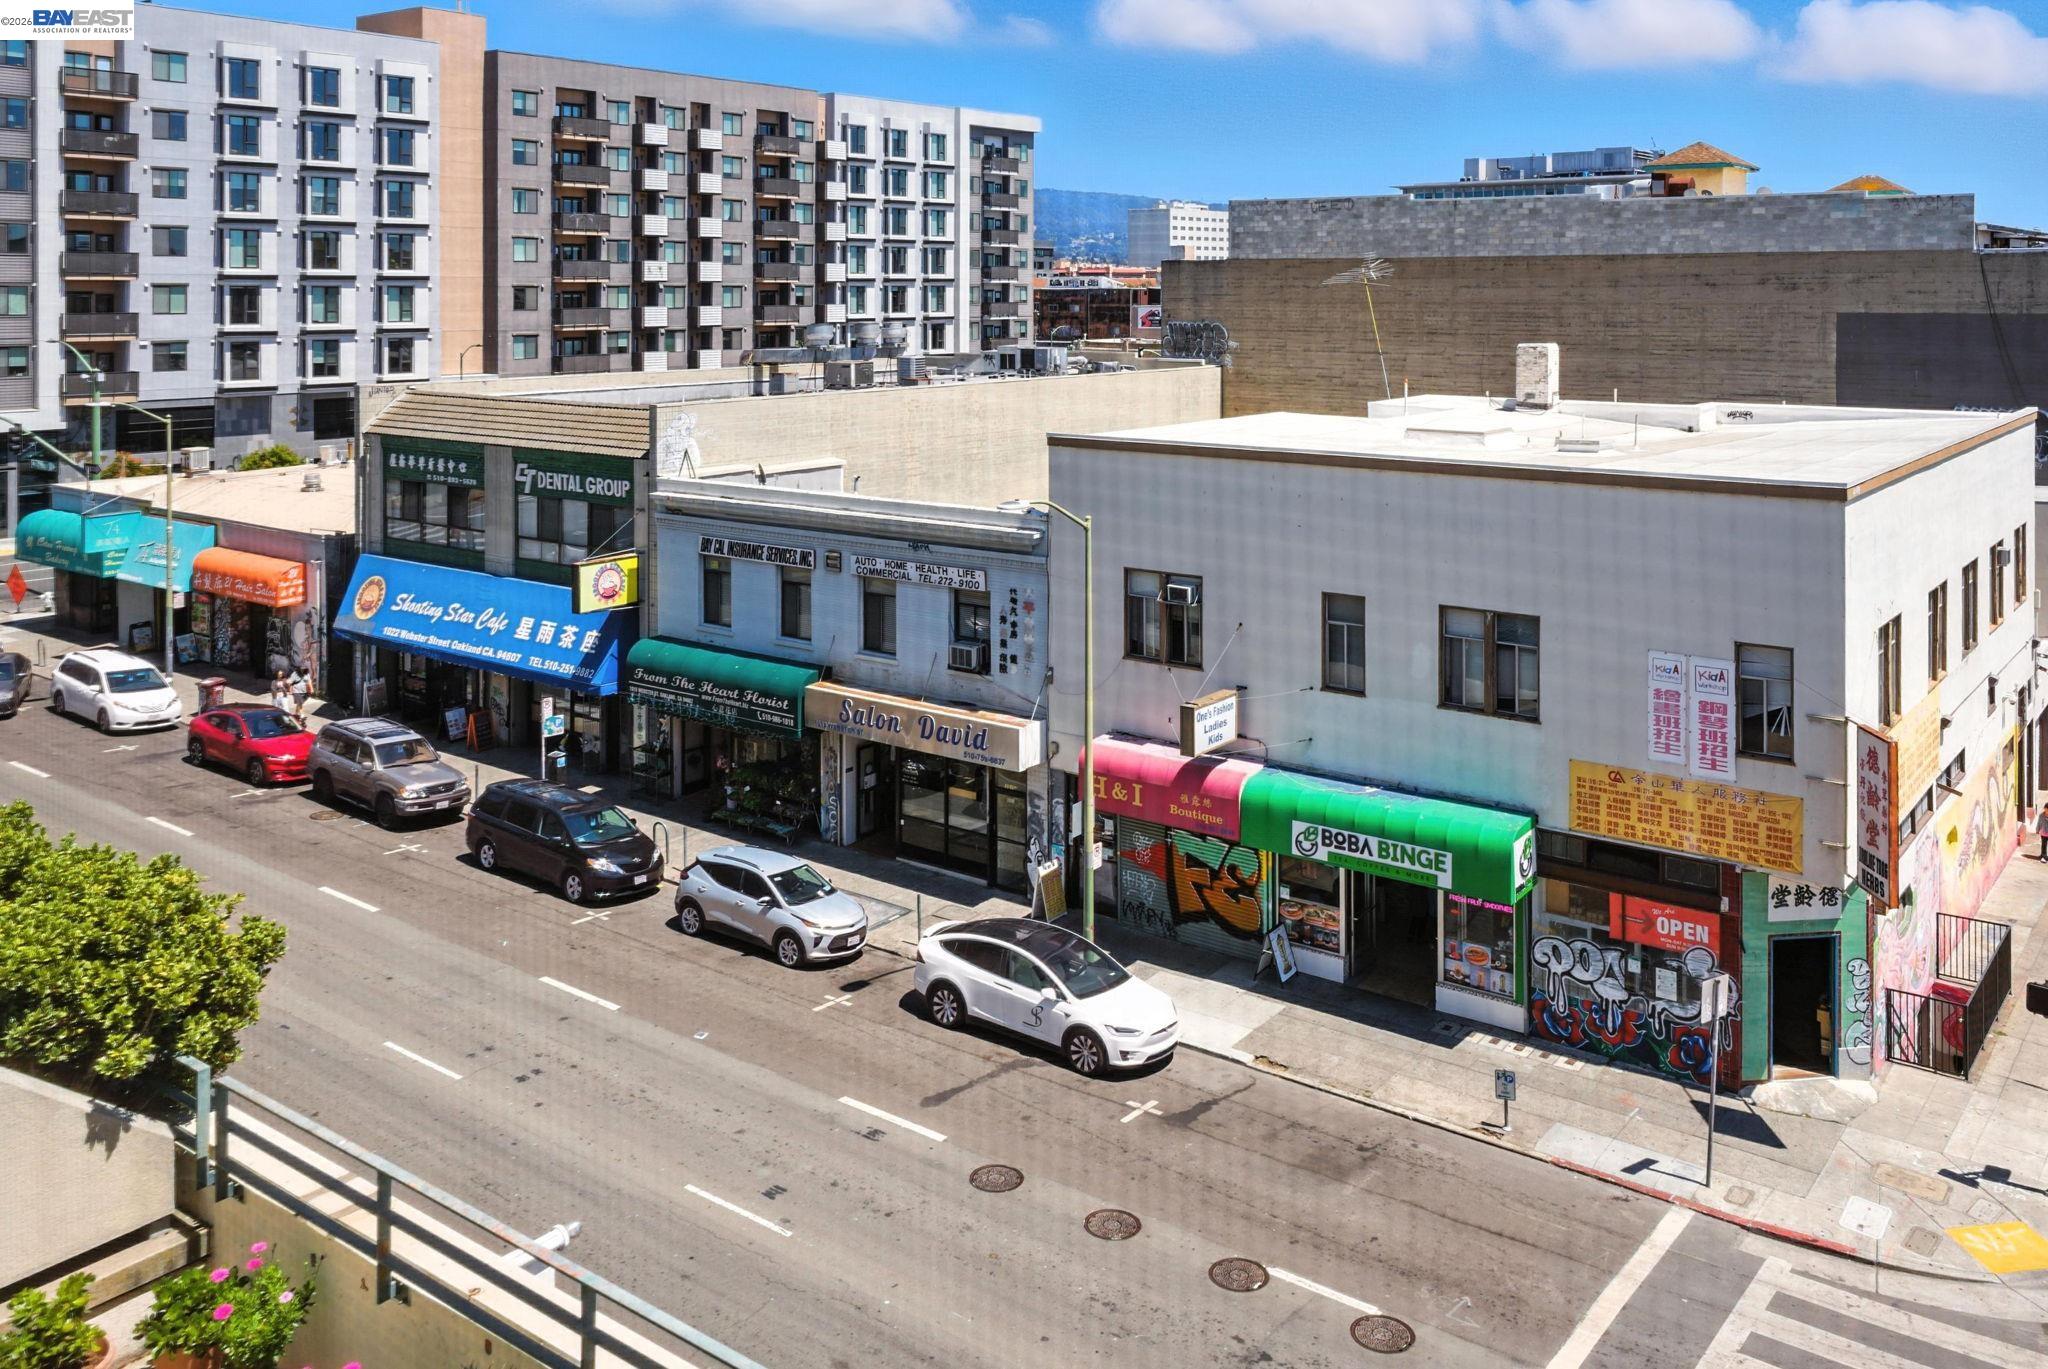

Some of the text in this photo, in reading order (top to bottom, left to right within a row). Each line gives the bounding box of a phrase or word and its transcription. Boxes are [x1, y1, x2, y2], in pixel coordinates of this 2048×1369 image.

[538, 471, 583, 493] DENTAL
[586, 477, 631, 498] GROUP
[701, 537, 713, 553] BAY
[714, 539, 726, 555] CAL
[727, 541, 766, 561] INSURANCE
[855, 558, 976, 579] AUTO HOME HEALTH LIFE
[856, 566, 912, 582] COMMERCIAL
[938, 577, 980, 590] 272-9100
[235, 579, 253, 593] Hair
[256, 583, 277, 598] Salon
[391, 593, 443, 624] Shooting
[443, 603, 474, 624] Star
[474, 606, 511, 636] Cafe
[400, 629, 428, 644] Webster
[428, 634, 450, 648] Street
[451, 640, 482, 655] Oakland
[514, 615, 602, 654] 星雨茶座
[633, 668, 790, 711] From The Heart Florist
[839, 698, 902, 733] Salon
[918, 714, 989, 751] David
[1196, 701, 1234, 723] One's Fashion
[1203, 719, 1228, 735] Ladies
[1208, 733, 1223, 746] Kids
[1169, 804, 1223, 825] Boutique
[1321, 828, 1448, 873] BOBA BINGE
[1861, 867, 1885, 898] HERBS
[1656, 916, 1709, 945] OPEN
